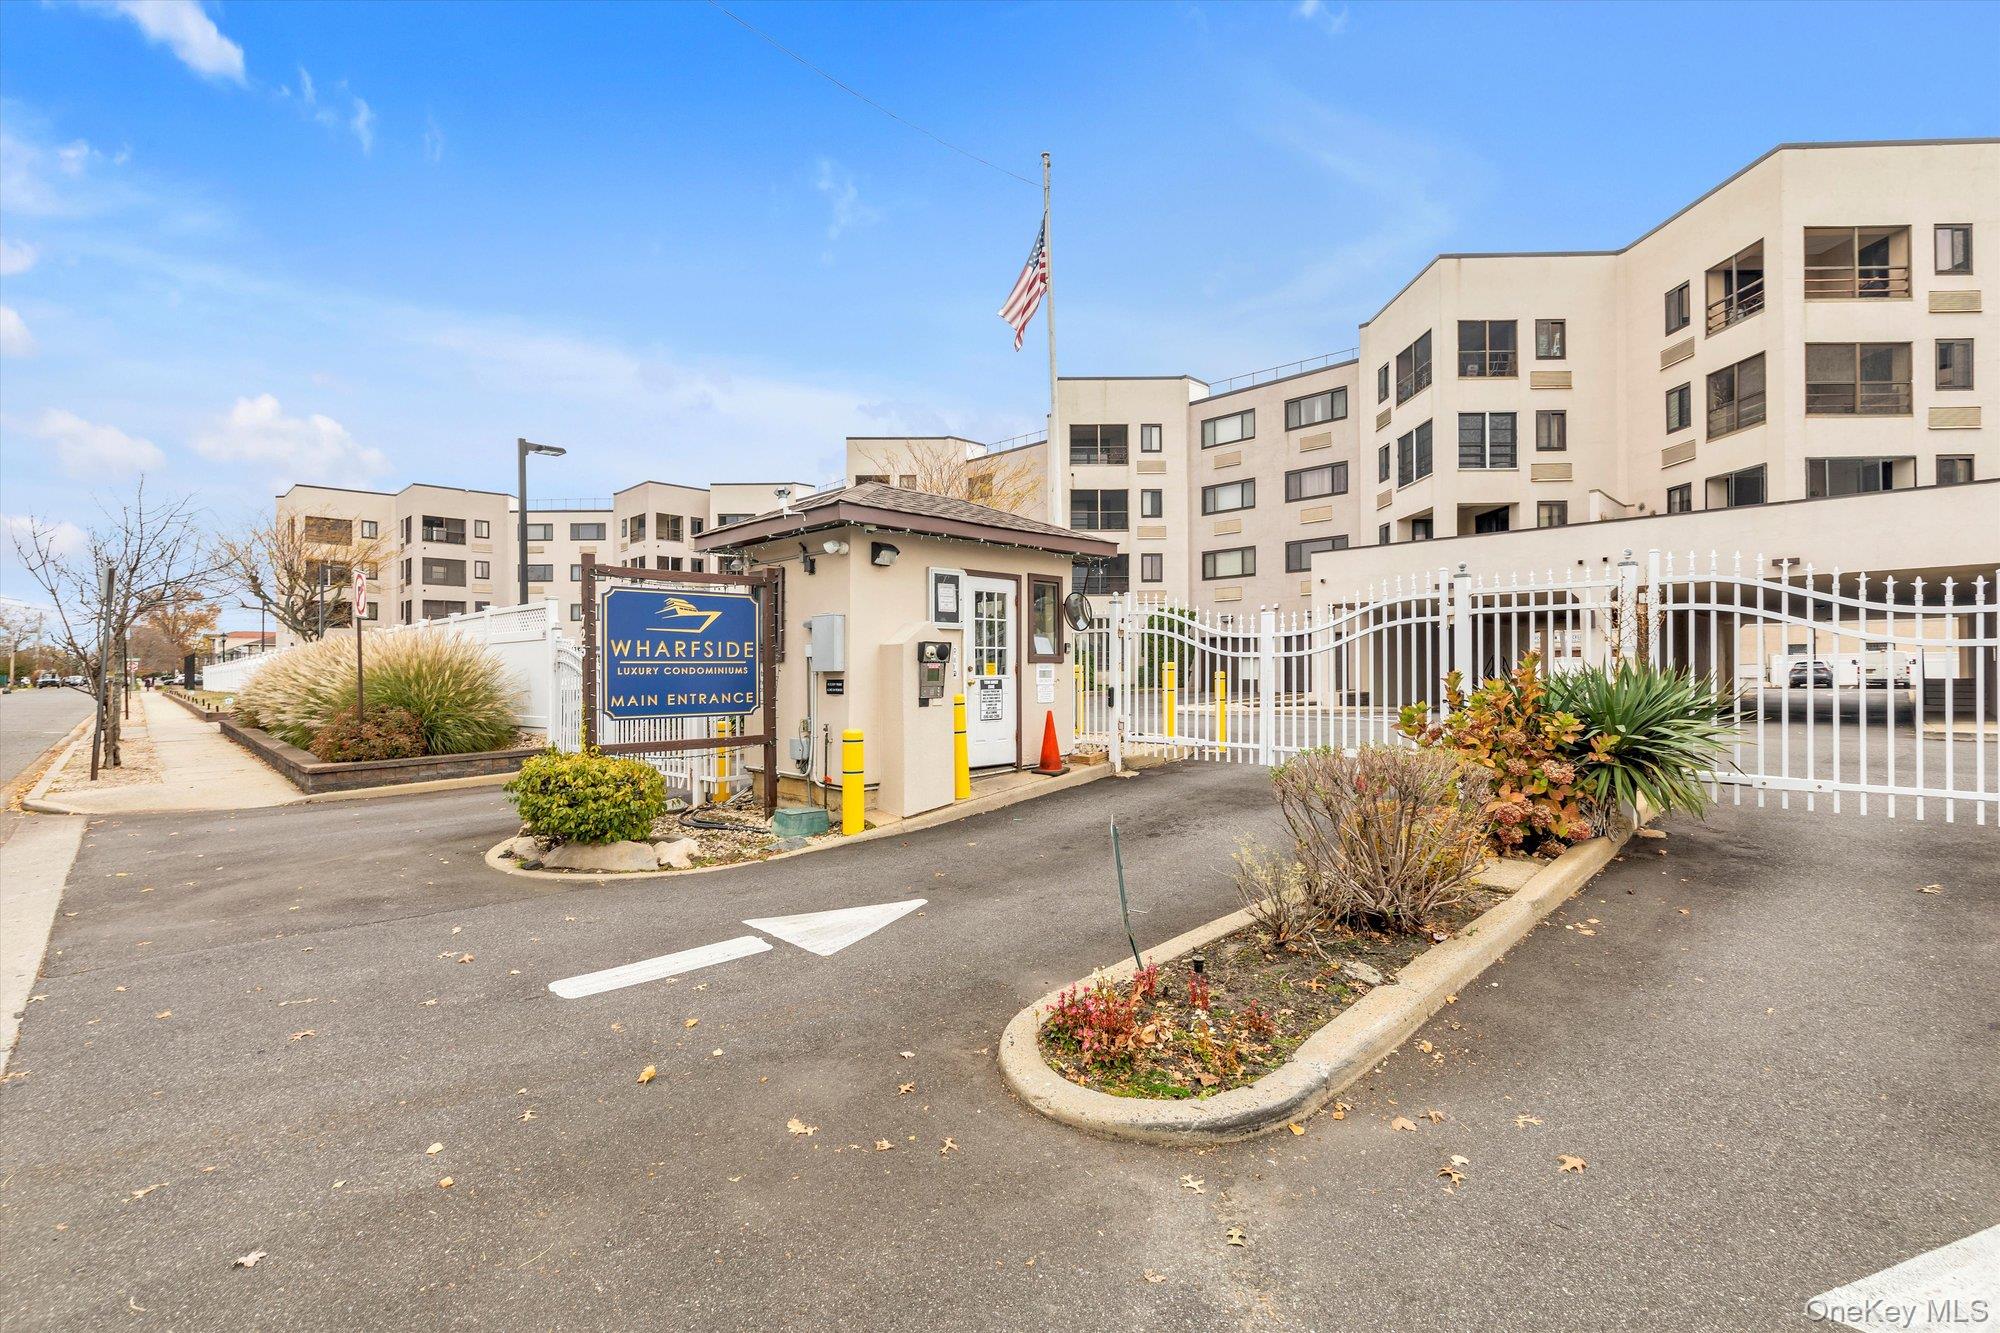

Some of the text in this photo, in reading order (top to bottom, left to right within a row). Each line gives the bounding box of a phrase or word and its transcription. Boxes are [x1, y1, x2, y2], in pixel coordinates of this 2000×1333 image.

[610, 639, 754, 658] WHARFSIDE
[617, 666, 748, 675] LUXURY CONDOMINIUMS
[610, 692, 754, 708] MAIN ENTRANCE
